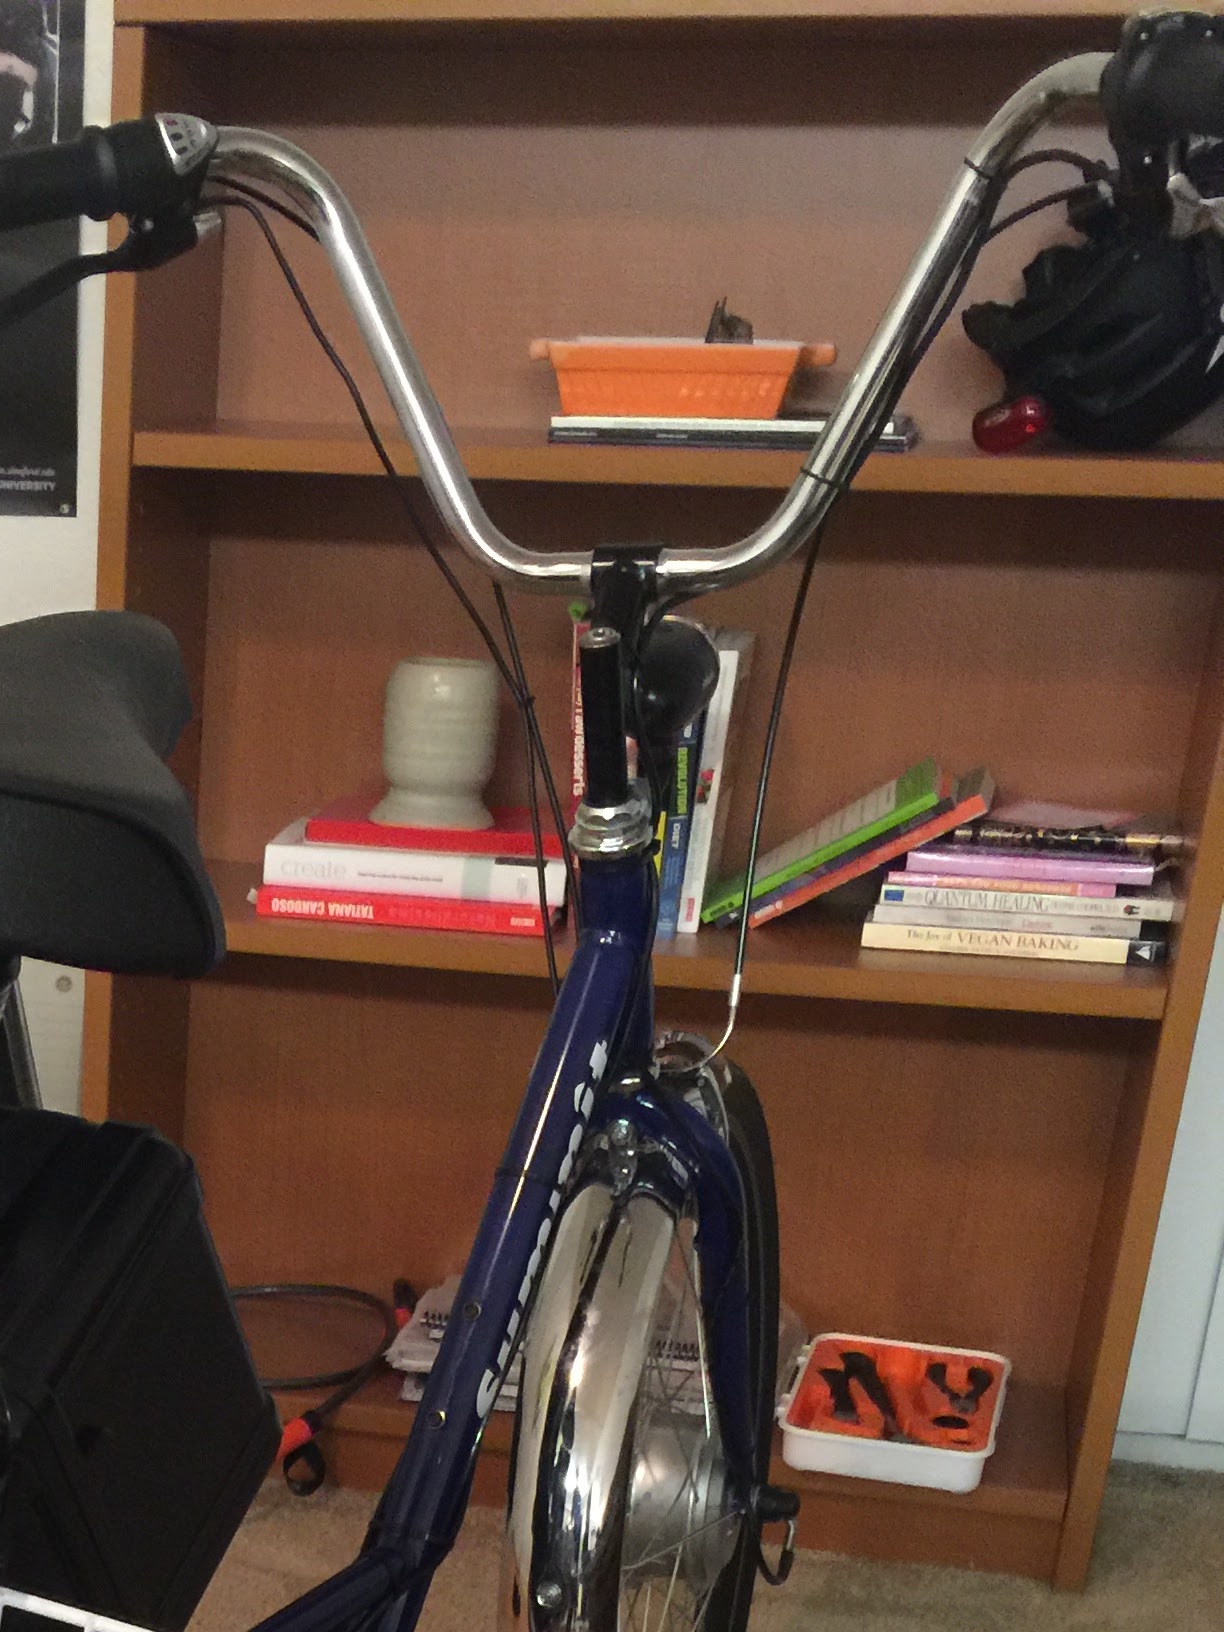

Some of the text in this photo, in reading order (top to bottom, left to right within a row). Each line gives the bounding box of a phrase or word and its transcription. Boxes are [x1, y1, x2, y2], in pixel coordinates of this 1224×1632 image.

[271, 897, 325, 915] CARDOSO
[328, 902, 374, 919] TATIANA
[925, 890, 987, 908] QUANTUM
[993, 894, 1049, 912] HEALING
[906, 929, 925, 940] The
[926, 931, 941, 943] Joy
[957, 932, 1013, 948] VEGAN
[1016, 935, 1079, 951] BAKING
